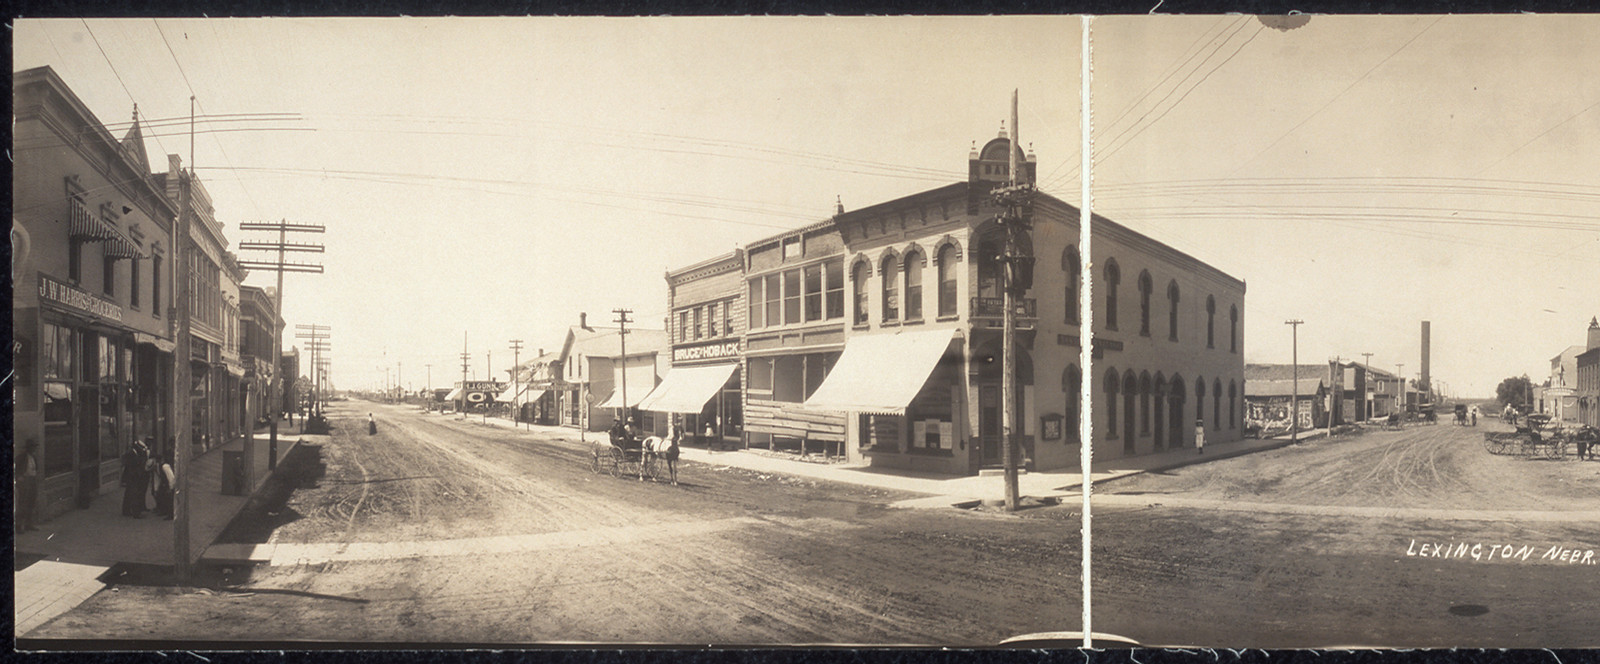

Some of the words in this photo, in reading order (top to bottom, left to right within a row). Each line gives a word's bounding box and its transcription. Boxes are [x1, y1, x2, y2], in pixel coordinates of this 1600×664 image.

[985, 165, 1010, 175] BAN
[60, 284, 86, 310] HARRIS
[674, 346, 700, 361] BRUCE
